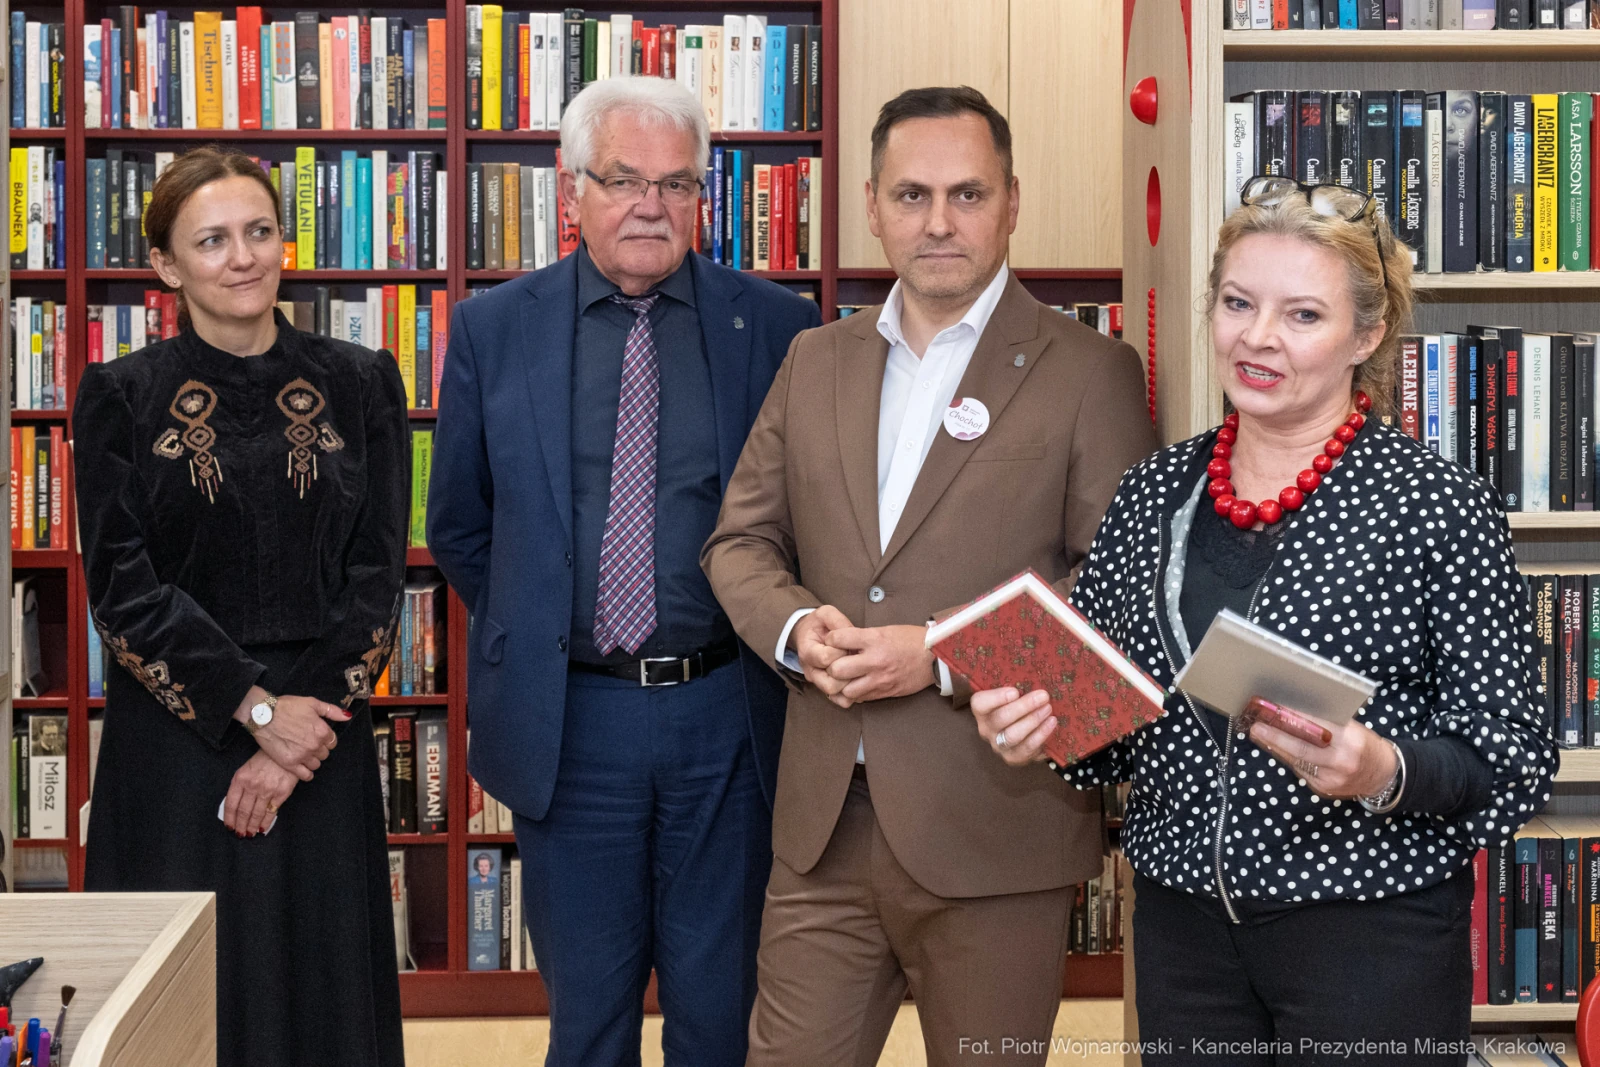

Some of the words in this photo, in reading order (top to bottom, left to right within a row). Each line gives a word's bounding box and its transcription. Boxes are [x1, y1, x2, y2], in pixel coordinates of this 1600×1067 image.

[203, 28, 218, 95] Tischner
[395, 53, 404, 77] JAN
[431, 50, 445, 104] GUCCI
[468, 56, 481, 78] 1945
[791, 43, 800, 85] DZIESIĘCINA
[811, 41, 819, 86] PAŃSZCZYZNA
[386, 55, 396, 107] ENGLERT
[1514, 101, 1525, 126] DAVID
[1572, 98, 1582, 120] ÅSA
[1236, 152, 1244, 174] ofiara
[1431, 132, 1440, 188] LÄCKBERG
[1514, 127, 1525, 184] LAGERCRANTZ
[1538, 108, 1555, 188] LAGERCRANTZ
[1570, 121, 1582, 196] LARSSON
[421, 158, 432, 184] Miss
[1373, 158, 1386, 189] Camilla
[1407, 158, 1420, 189] Camilla
[13, 182, 24, 238] BRAUNEK
[299, 164, 312, 233] VETULANI
[421, 186, 433, 211] Dior
[757, 193, 769, 217] BYŁEM
[1407, 192, 1422, 230] LÄCKBERG
[1459, 202, 1464, 210] CO
[1514, 193, 1524, 239] MEMORIA
[757, 220, 769, 261] SZPIEGIEM
[1448, 345, 1457, 374] DENNIS
[1507, 350, 1517, 374] DENNIS
[1533, 347, 1541, 382] DENNIS
[1403, 350, 1417, 411] LEHANE
[1429, 370, 1440, 392] DENNIS
[1448, 376, 1457, 407] LEHANE
[1487, 364, 1496, 413] TAJEMNIC
[1507, 374, 1518, 397] LEHANE
[1428, 393, 1440, 417] LEHANE
[1447, 410, 1457, 430] Wyspa
[1533, 385, 1541, 420] LEHANE
[1557, 401, 1568, 438] KLĄTWA
[1487, 415, 1496, 451] WYSPA
[1580, 416, 1588, 439] Bogini
[24, 475, 33, 529] MESSNER
[52, 477, 62, 526] URUBKO
[1544, 582, 1552, 646] NAJSŁABSZE
[1572, 591, 1580, 631] ROBERT
[1592, 587, 1600, 633] MAŁECKI
[395, 743, 412, 781] D-DAY
[427, 744, 441, 817] EDELMAN
[44, 761, 59, 811] Miłosz
[1521, 849, 1531, 861] 2
[1568, 849, 1576, 861] 6
[1544, 873, 1552, 908] MANKELL
[1591, 860, 1599, 902] MARININA
[473, 890, 484, 932] Thatcher
[483, 889, 495, 931] Margaret
[502, 905, 512, 940] Tochman
[1542, 910, 1557, 941] RĘKA
